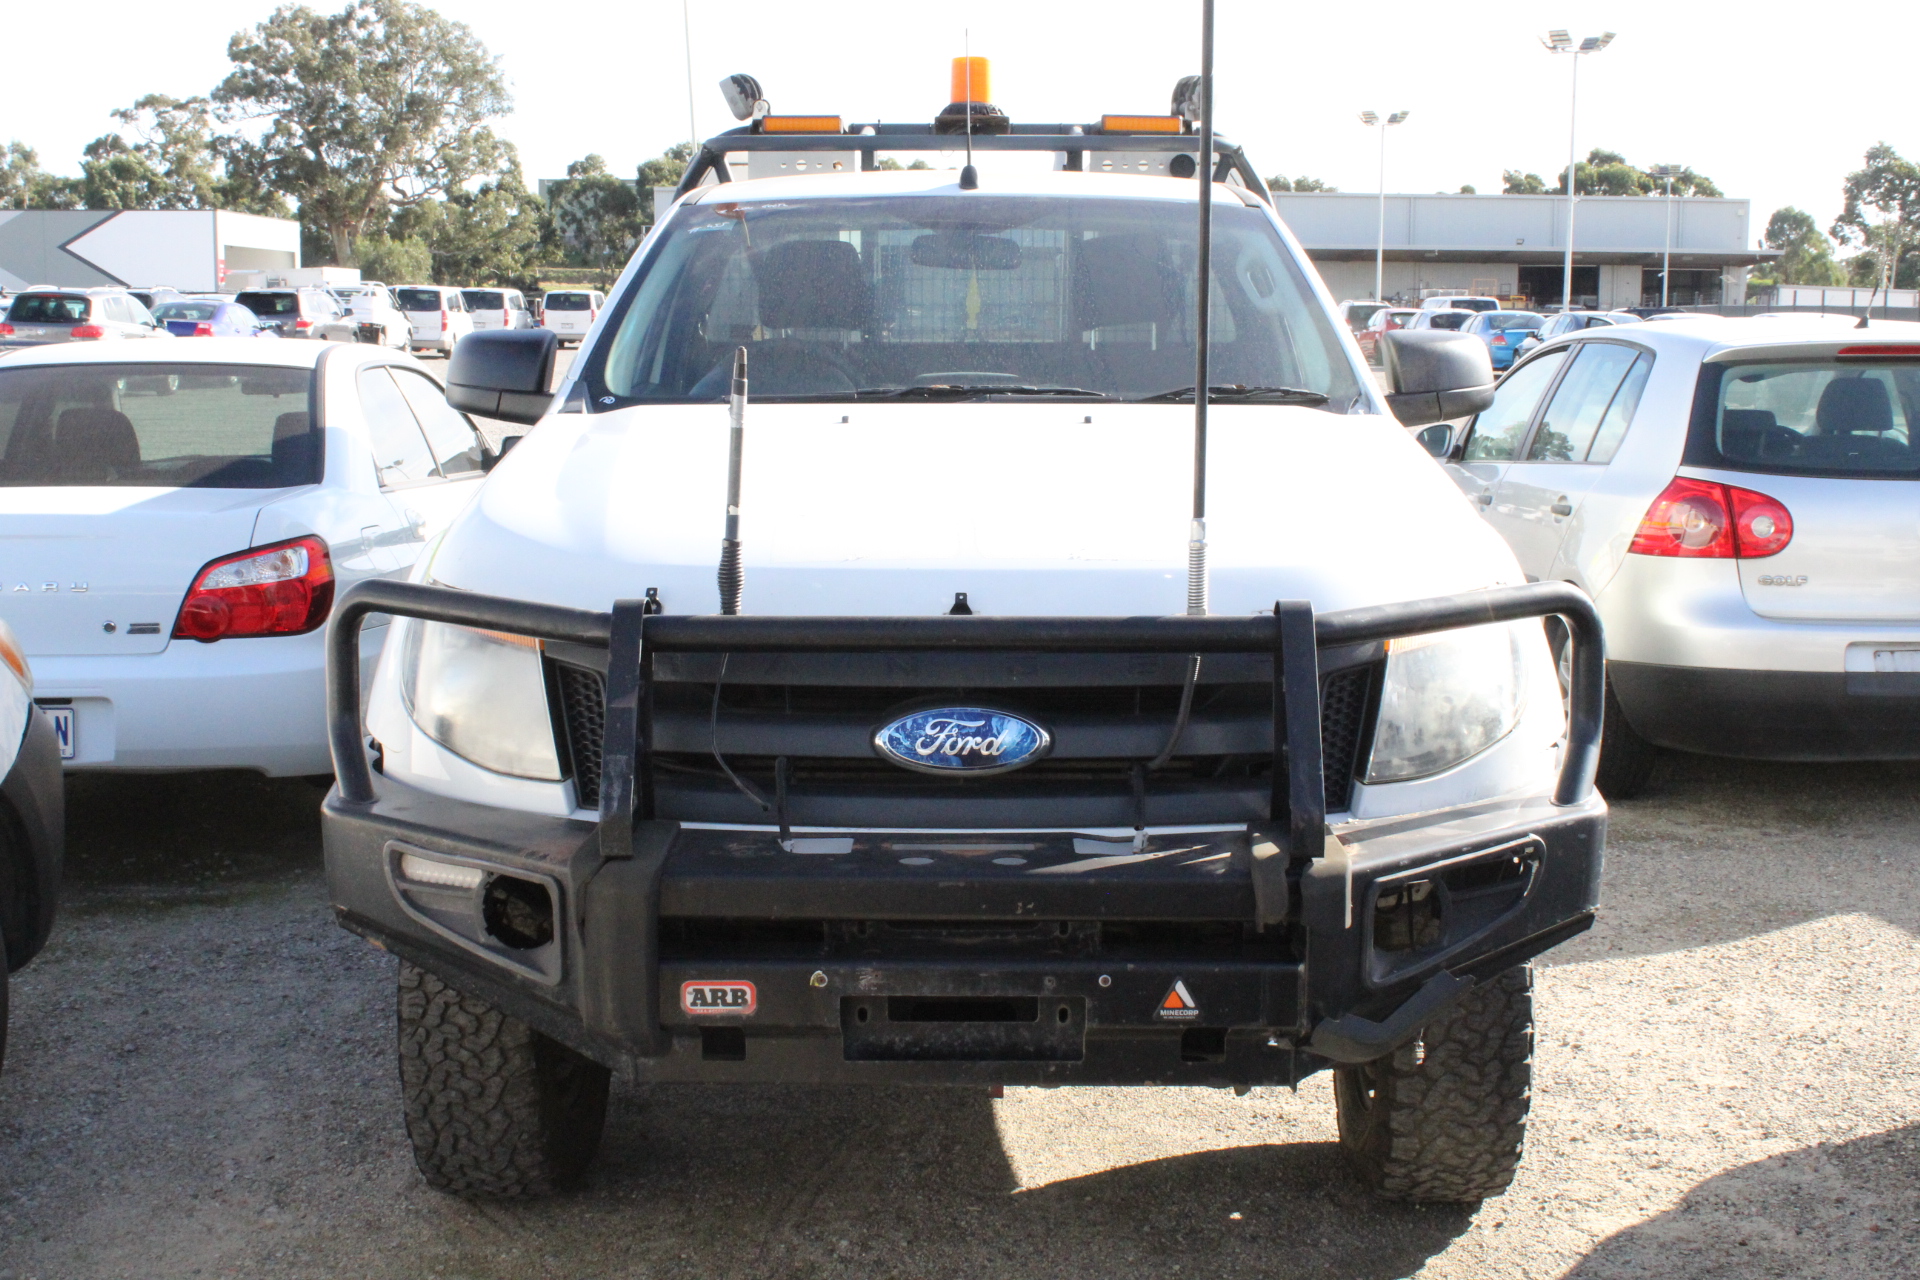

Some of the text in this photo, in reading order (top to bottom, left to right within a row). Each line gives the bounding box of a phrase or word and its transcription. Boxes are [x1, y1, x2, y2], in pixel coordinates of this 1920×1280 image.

[0, 581, 89, 592] ARU
[1758, 575, 1808, 586] GOLF
[915, 718, 1009, 756] Ford
[690, 988, 748, 1008] ARB
